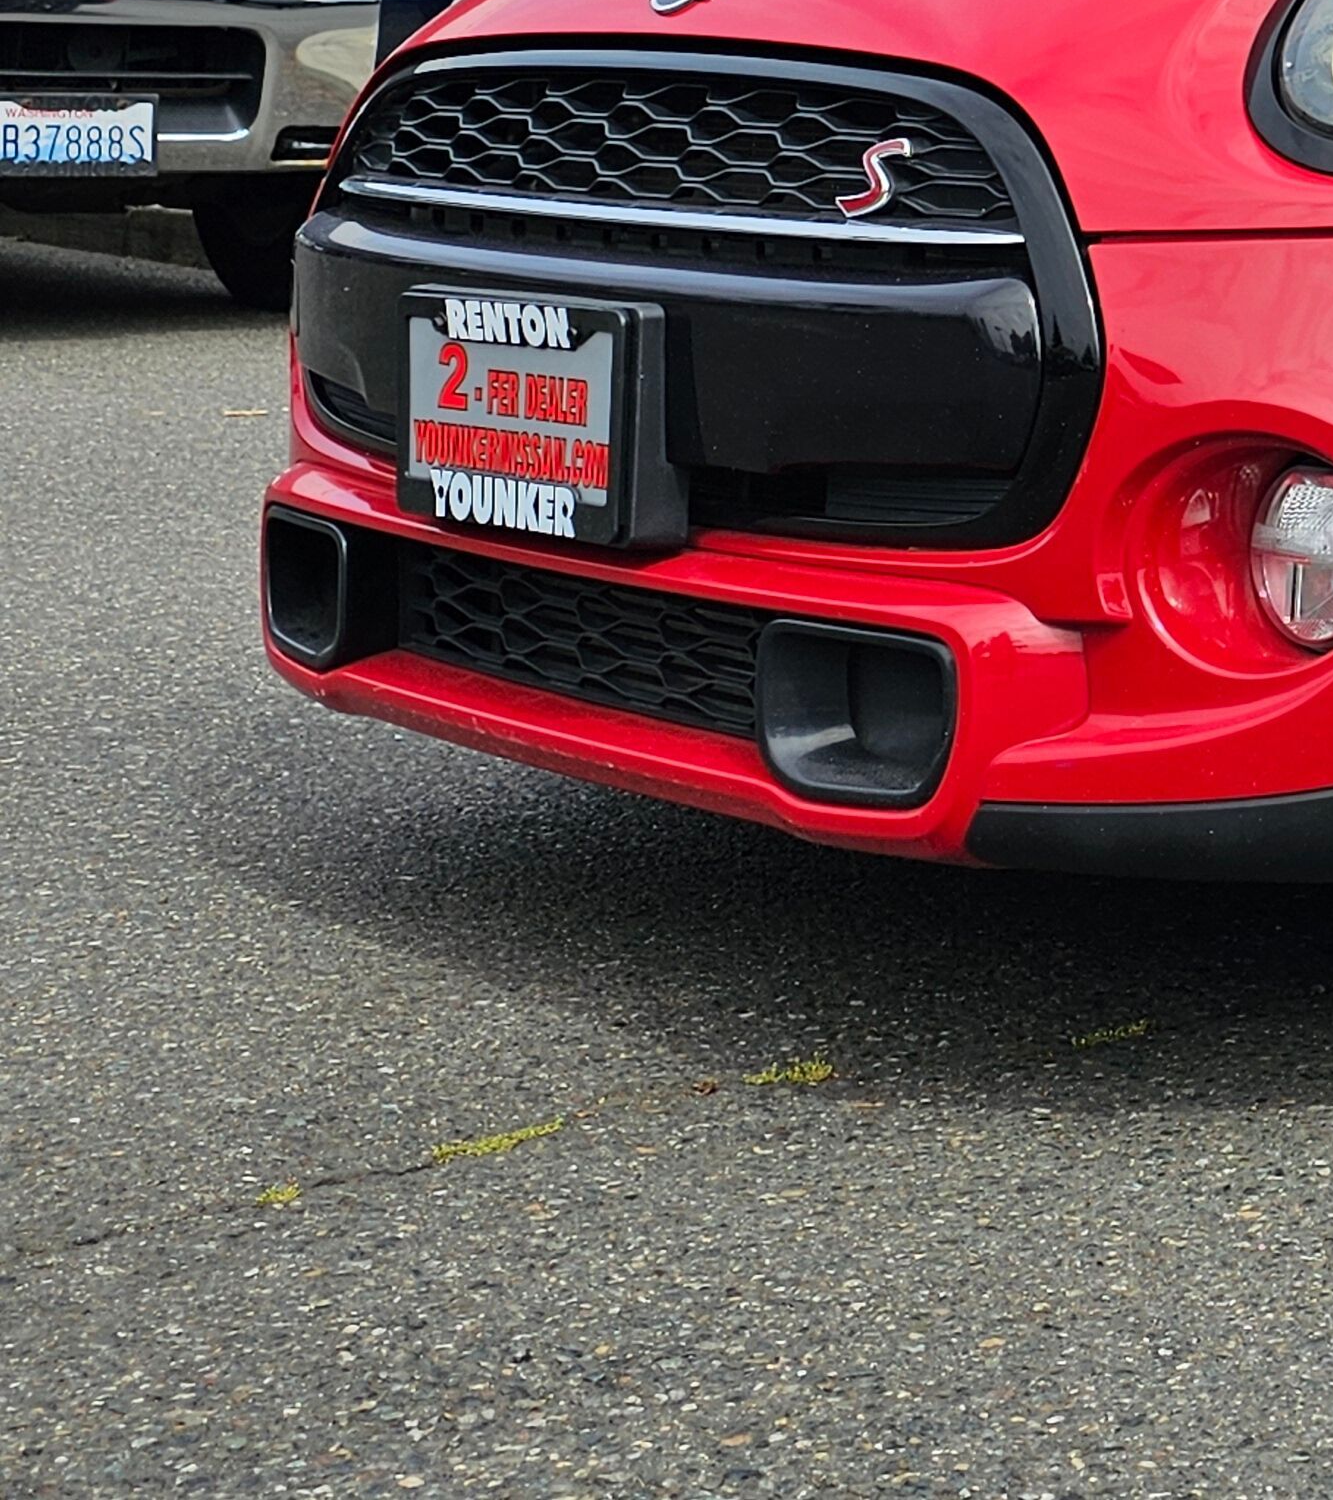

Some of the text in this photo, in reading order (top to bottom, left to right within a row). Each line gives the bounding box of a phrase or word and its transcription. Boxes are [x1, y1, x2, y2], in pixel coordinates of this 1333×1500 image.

[3, 124, 145, 161] B37888S
[835, 138, 911, 217] S
[445, 298, 571, 349] RENTON
[524, 372, 588, 428] DEALER
[413, 418, 611, 490] YOUNKERNISSAN.COM
[430, 467, 577, 539] YOUNKER
